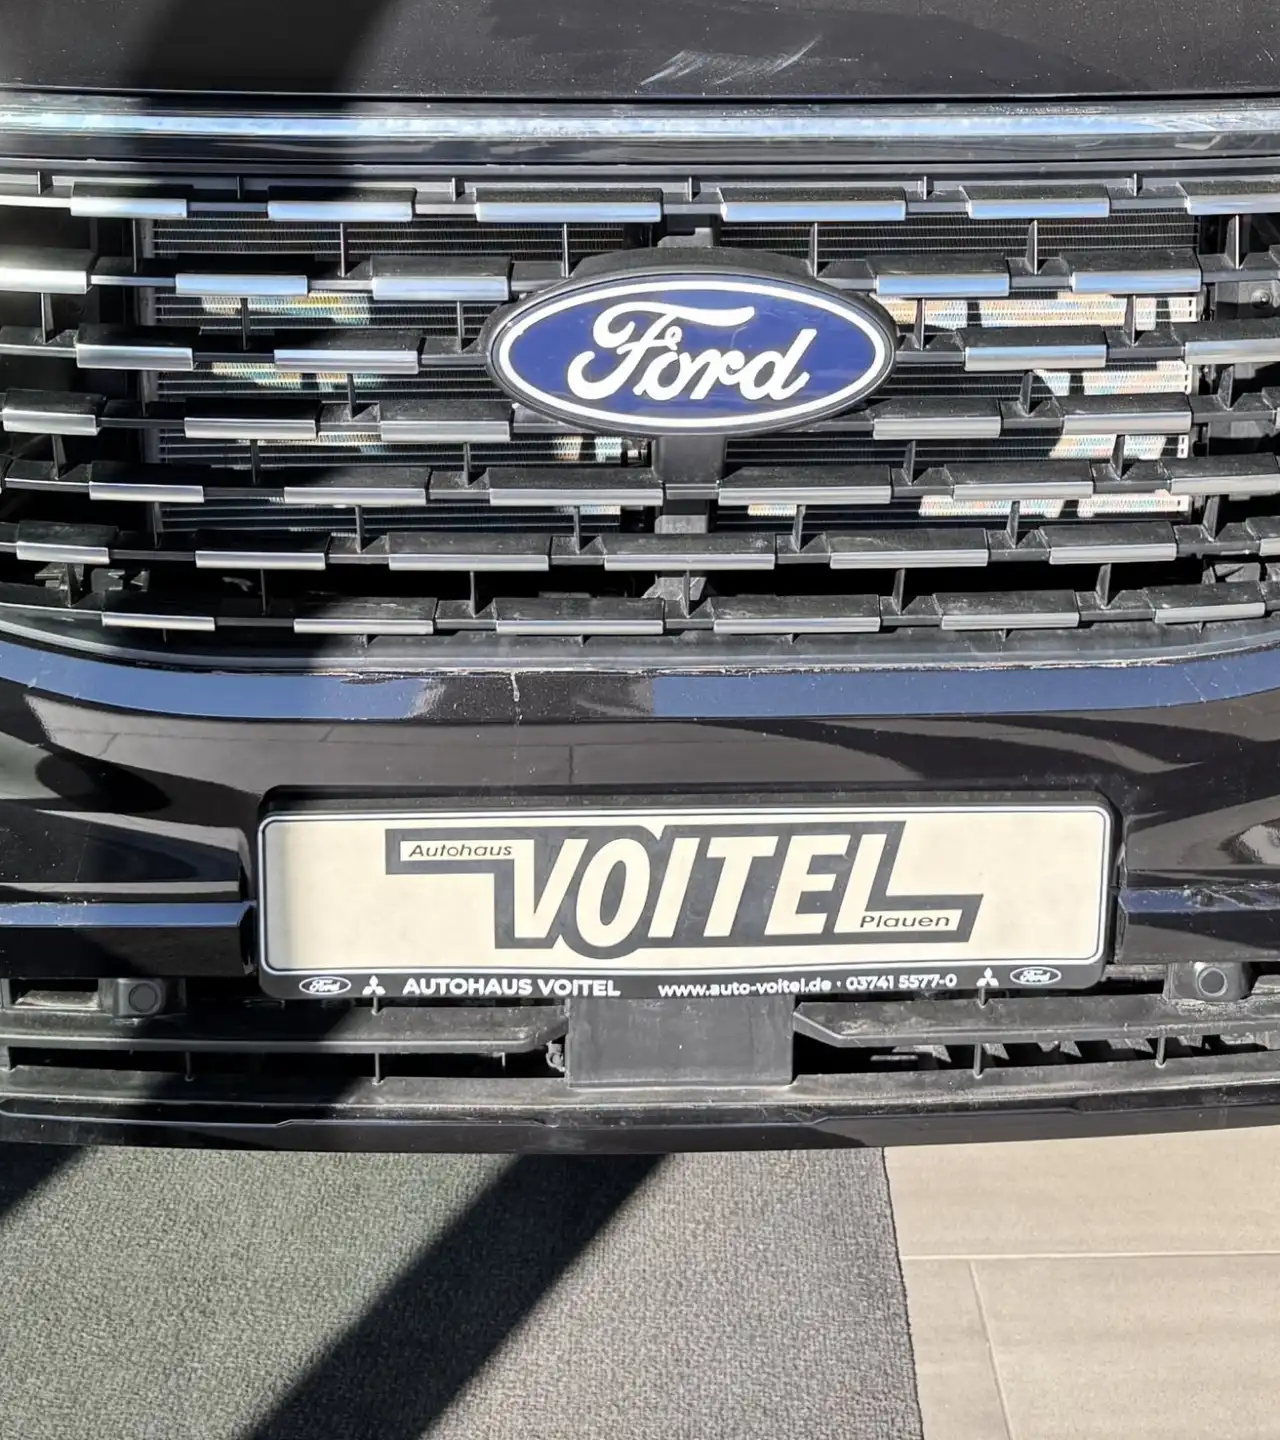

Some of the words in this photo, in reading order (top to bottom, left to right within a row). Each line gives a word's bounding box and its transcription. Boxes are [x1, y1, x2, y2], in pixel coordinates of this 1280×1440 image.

[567, 301, 818, 401] Ford
[408, 843, 513, 858] Autohaus
[510, 832, 900, 950] VOITEL
[859, 914, 951, 929] Plauen
[402, 977, 533, 996] AUTOHAUS
[537, 978, 621, 997] VOITEL
[657, 976, 833, 997] www.auto-voitel.de
[845, 975, 895, 991] 03741
[898, 973, 958, 990] 5577-0
